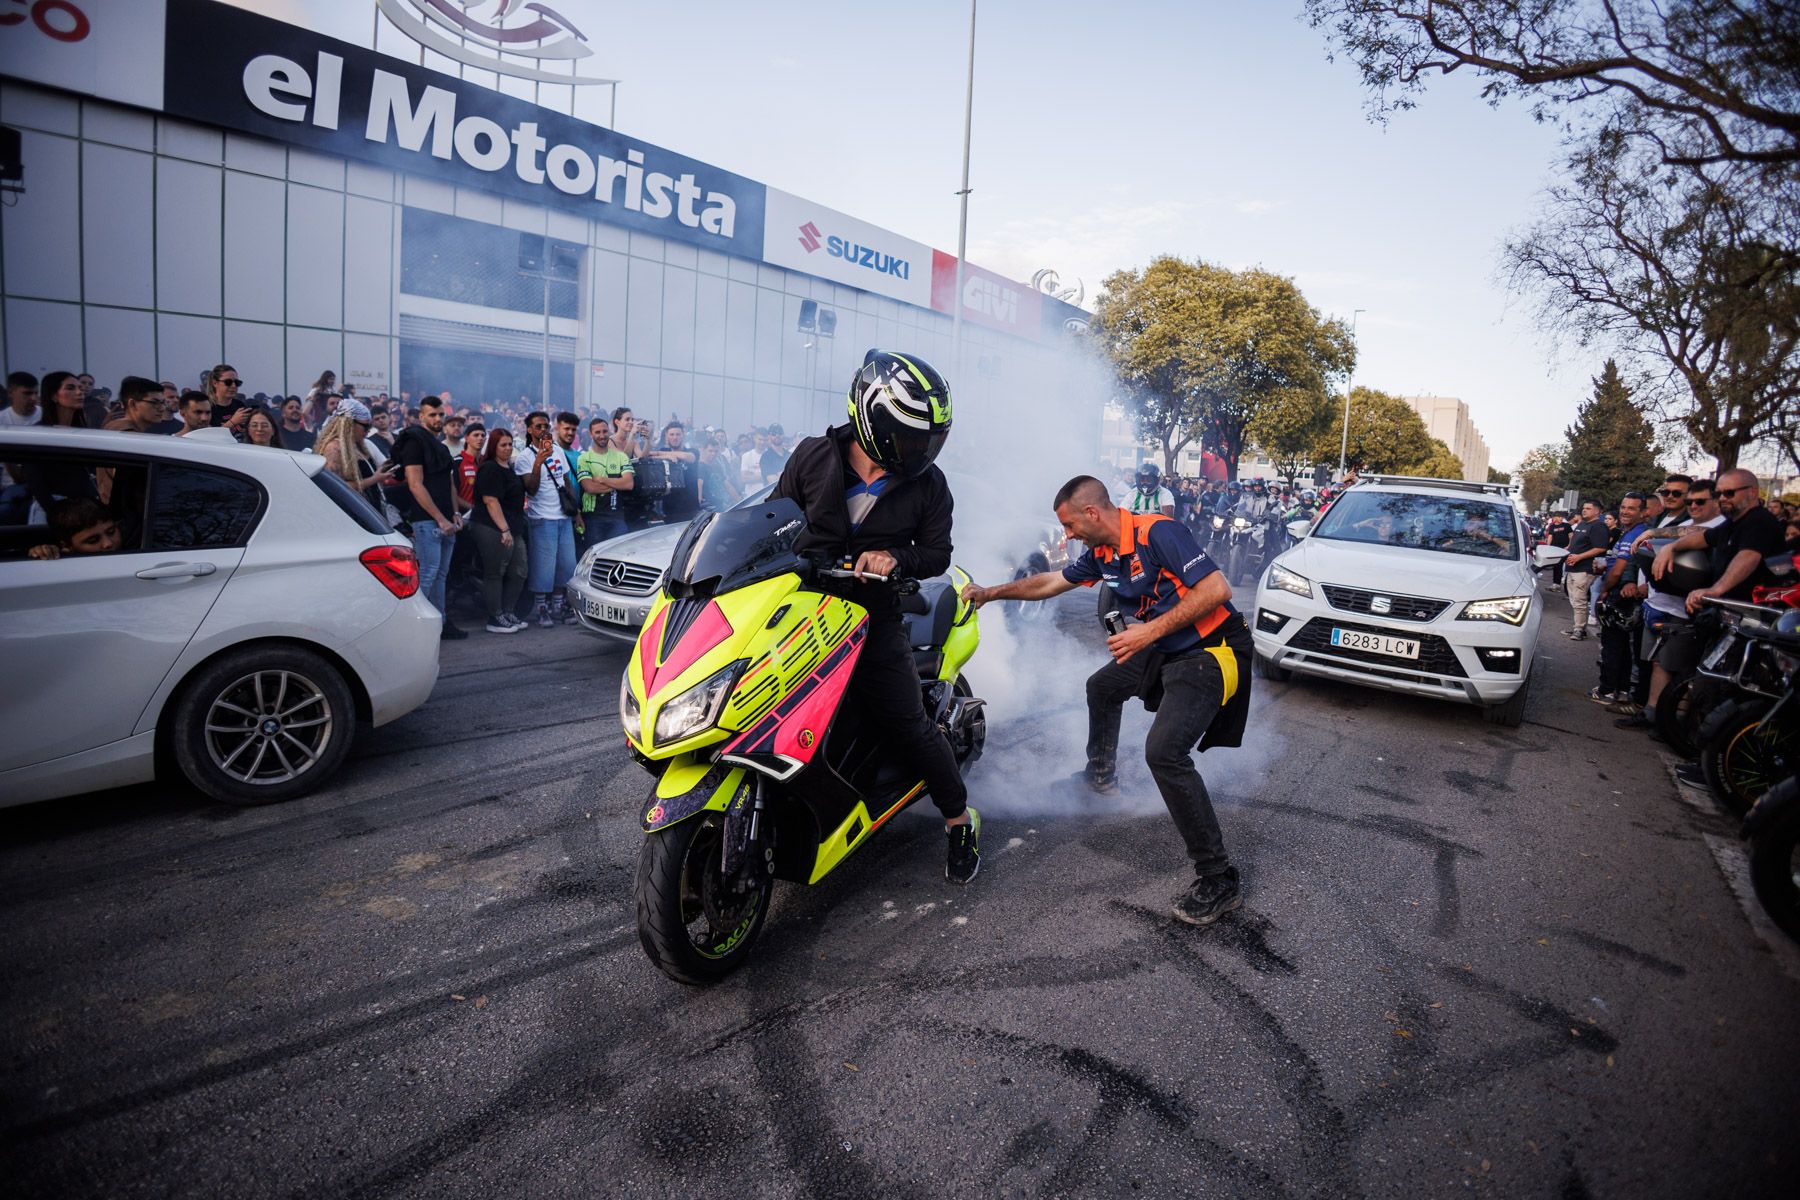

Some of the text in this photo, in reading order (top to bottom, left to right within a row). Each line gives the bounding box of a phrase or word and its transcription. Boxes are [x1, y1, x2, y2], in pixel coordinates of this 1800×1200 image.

[242, 50, 738, 239] el Motorista
[827, 234, 910, 281] SUZUKI
[586, 600, 605, 618] 8581
[1342, 632, 1415, 656] 6283 LCW
